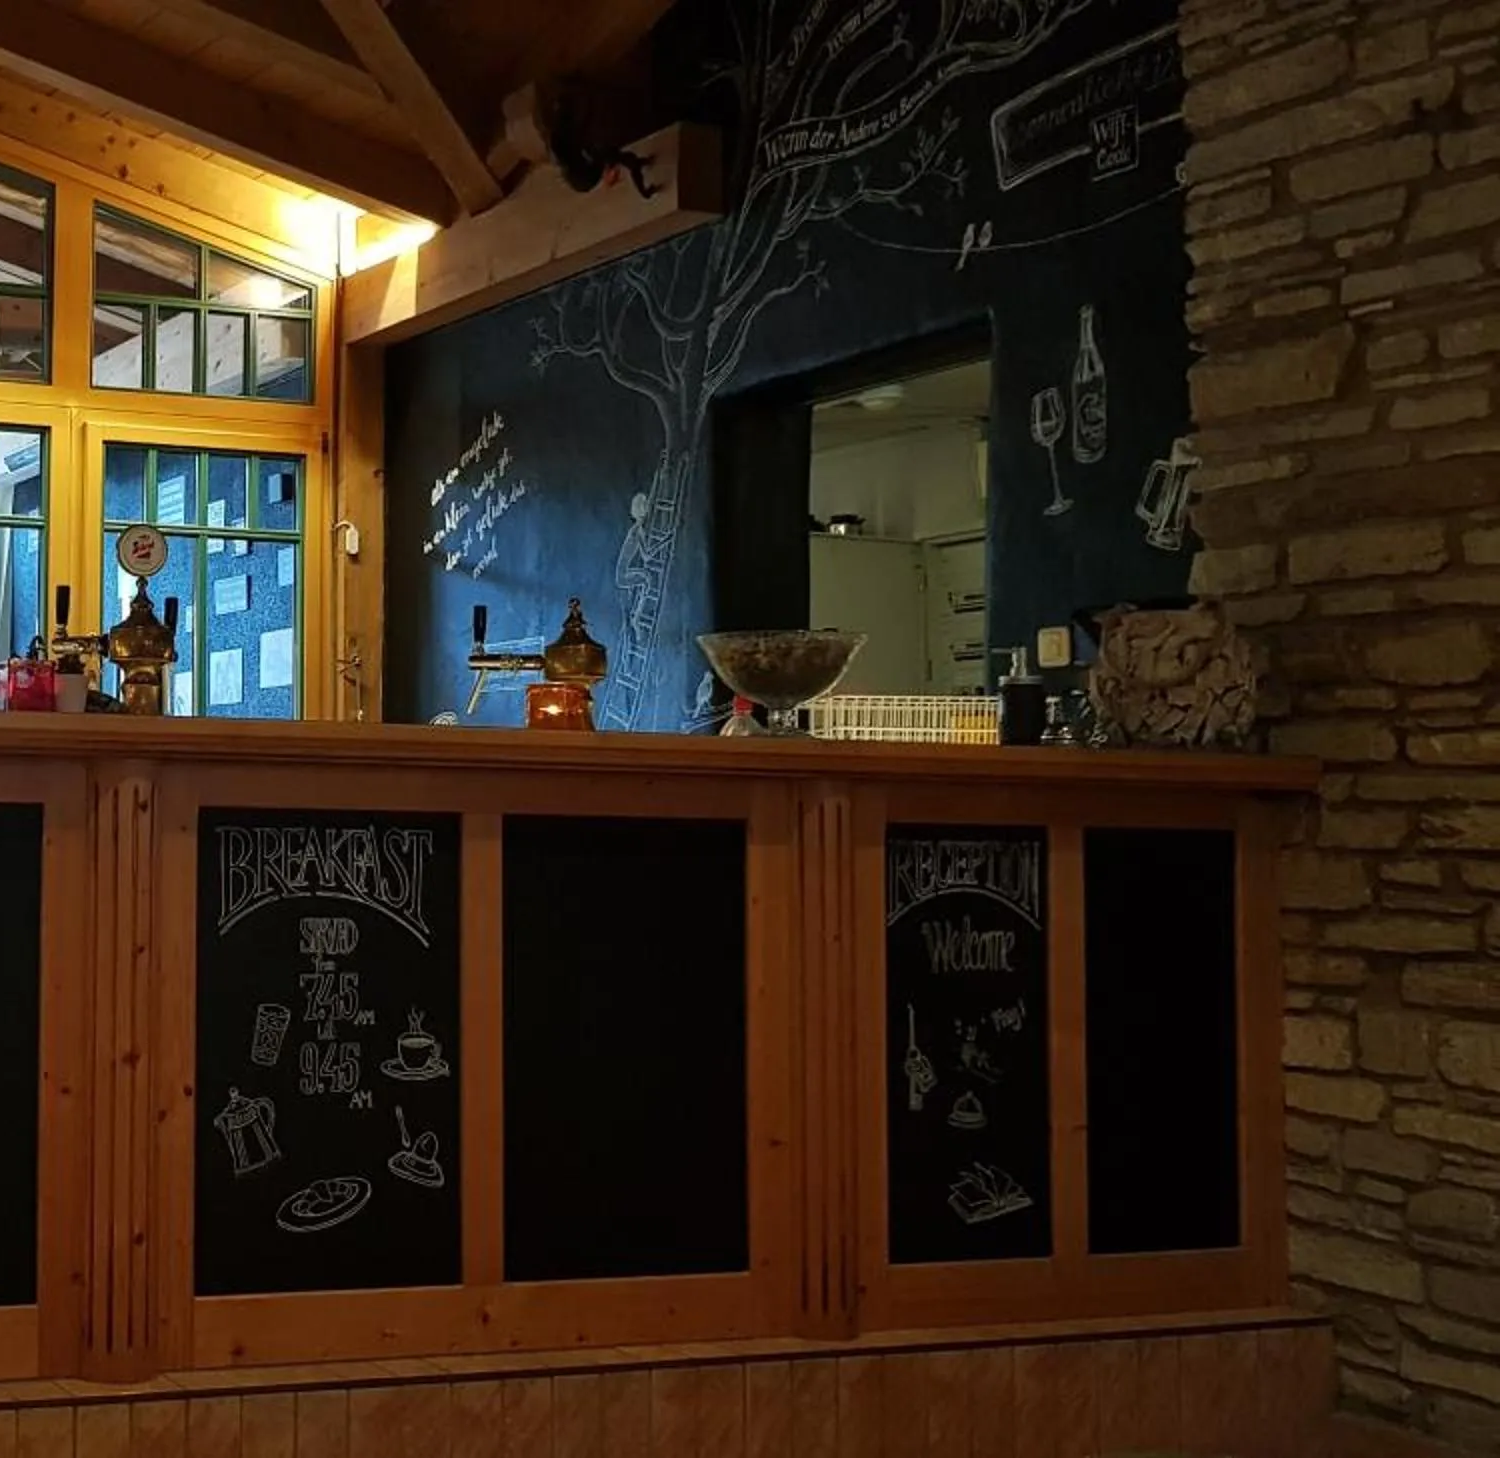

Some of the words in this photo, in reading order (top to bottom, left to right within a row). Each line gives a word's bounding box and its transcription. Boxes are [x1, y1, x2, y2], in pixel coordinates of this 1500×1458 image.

[214, 824, 434, 936] BREAKFAST
[887, 839, 1042, 921] RECEPTION
[920, 914, 1017, 975] Welcome
[353, 1009, 377, 1026] AM
[348, 1089, 375, 1109] AM
